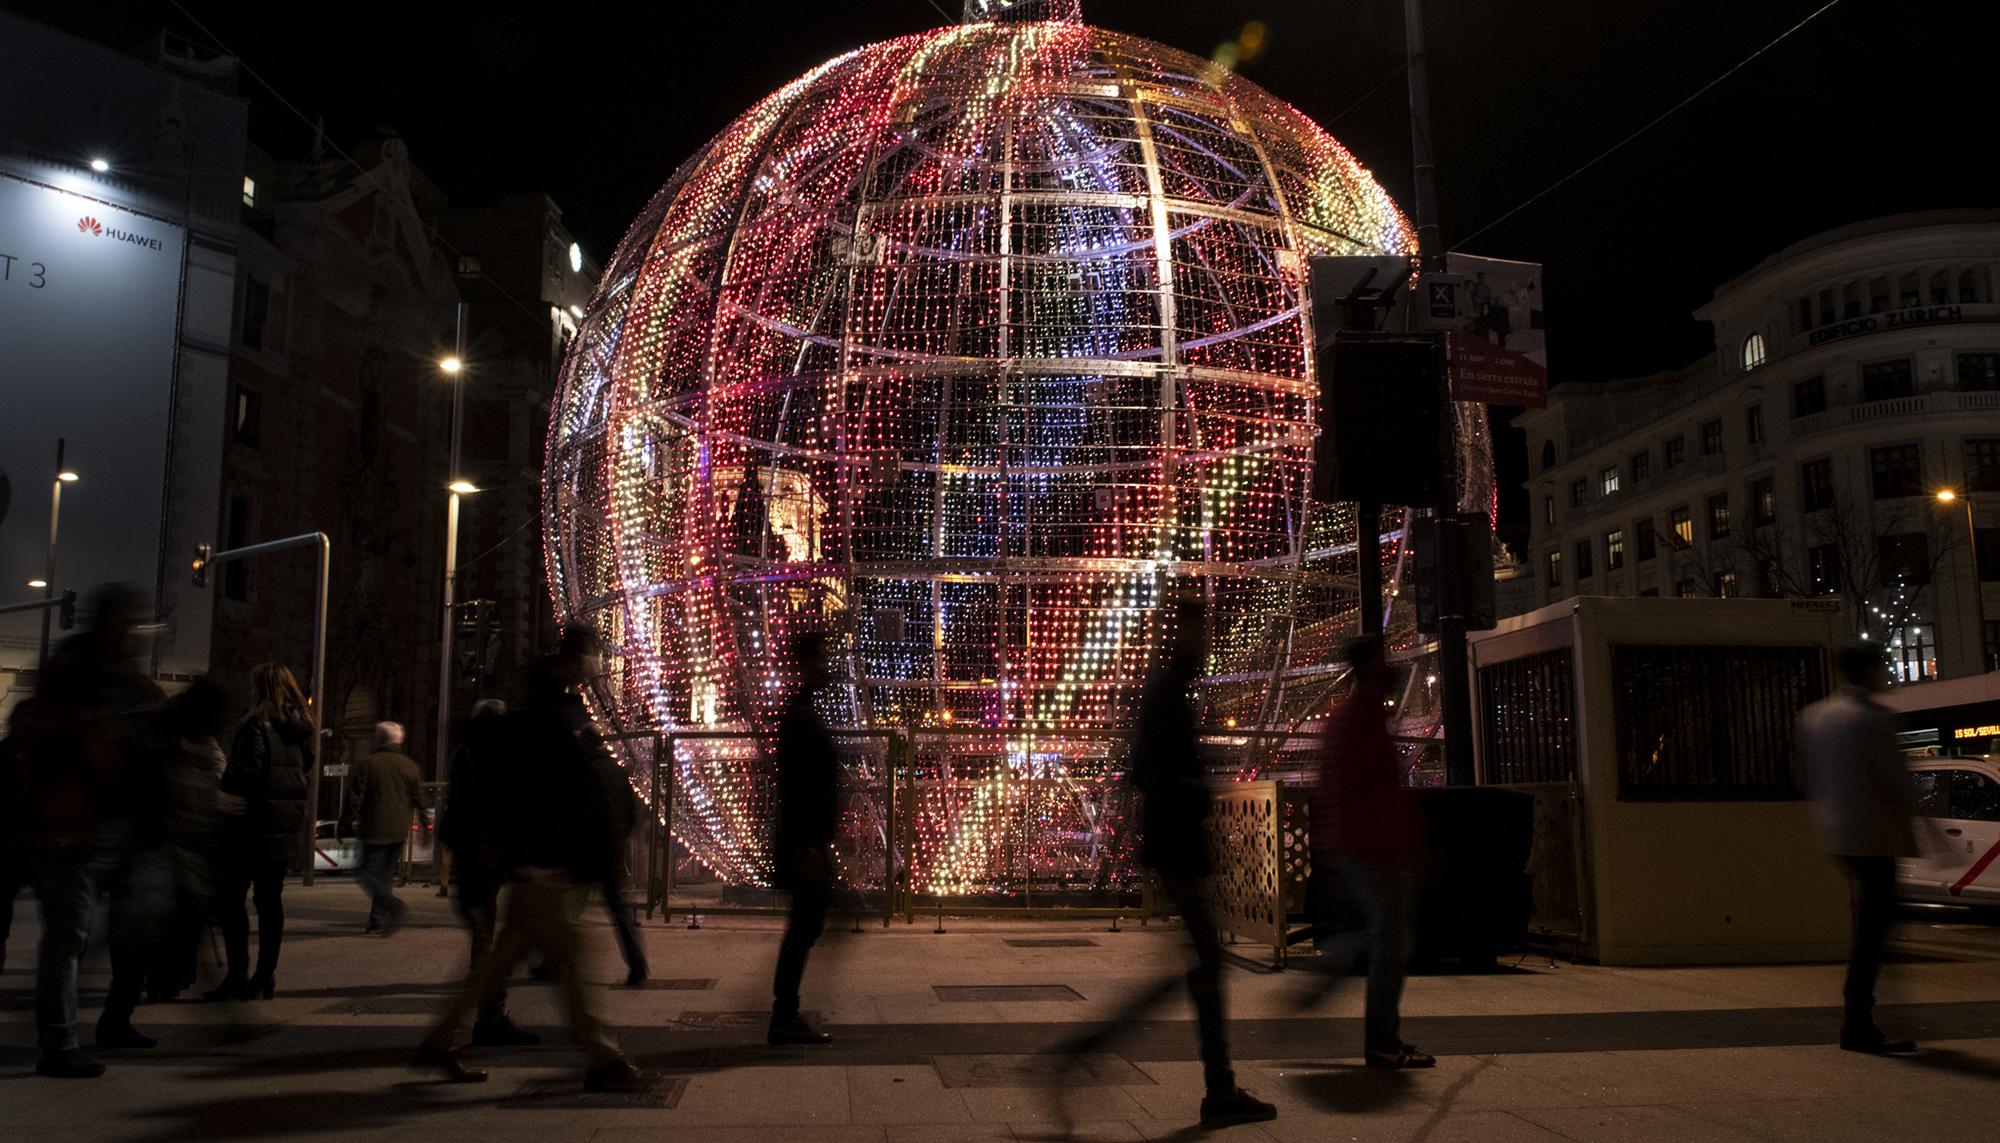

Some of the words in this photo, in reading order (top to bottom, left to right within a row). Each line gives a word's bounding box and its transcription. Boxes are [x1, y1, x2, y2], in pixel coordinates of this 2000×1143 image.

[106, 227, 163, 251] HUAWEI
[28, 262, 46, 289] 3
[1809, 318, 1876, 345] EDIFICIO
[1887, 306, 1962, 328] ZURICH
[1955, 729, 1963, 738] 15
